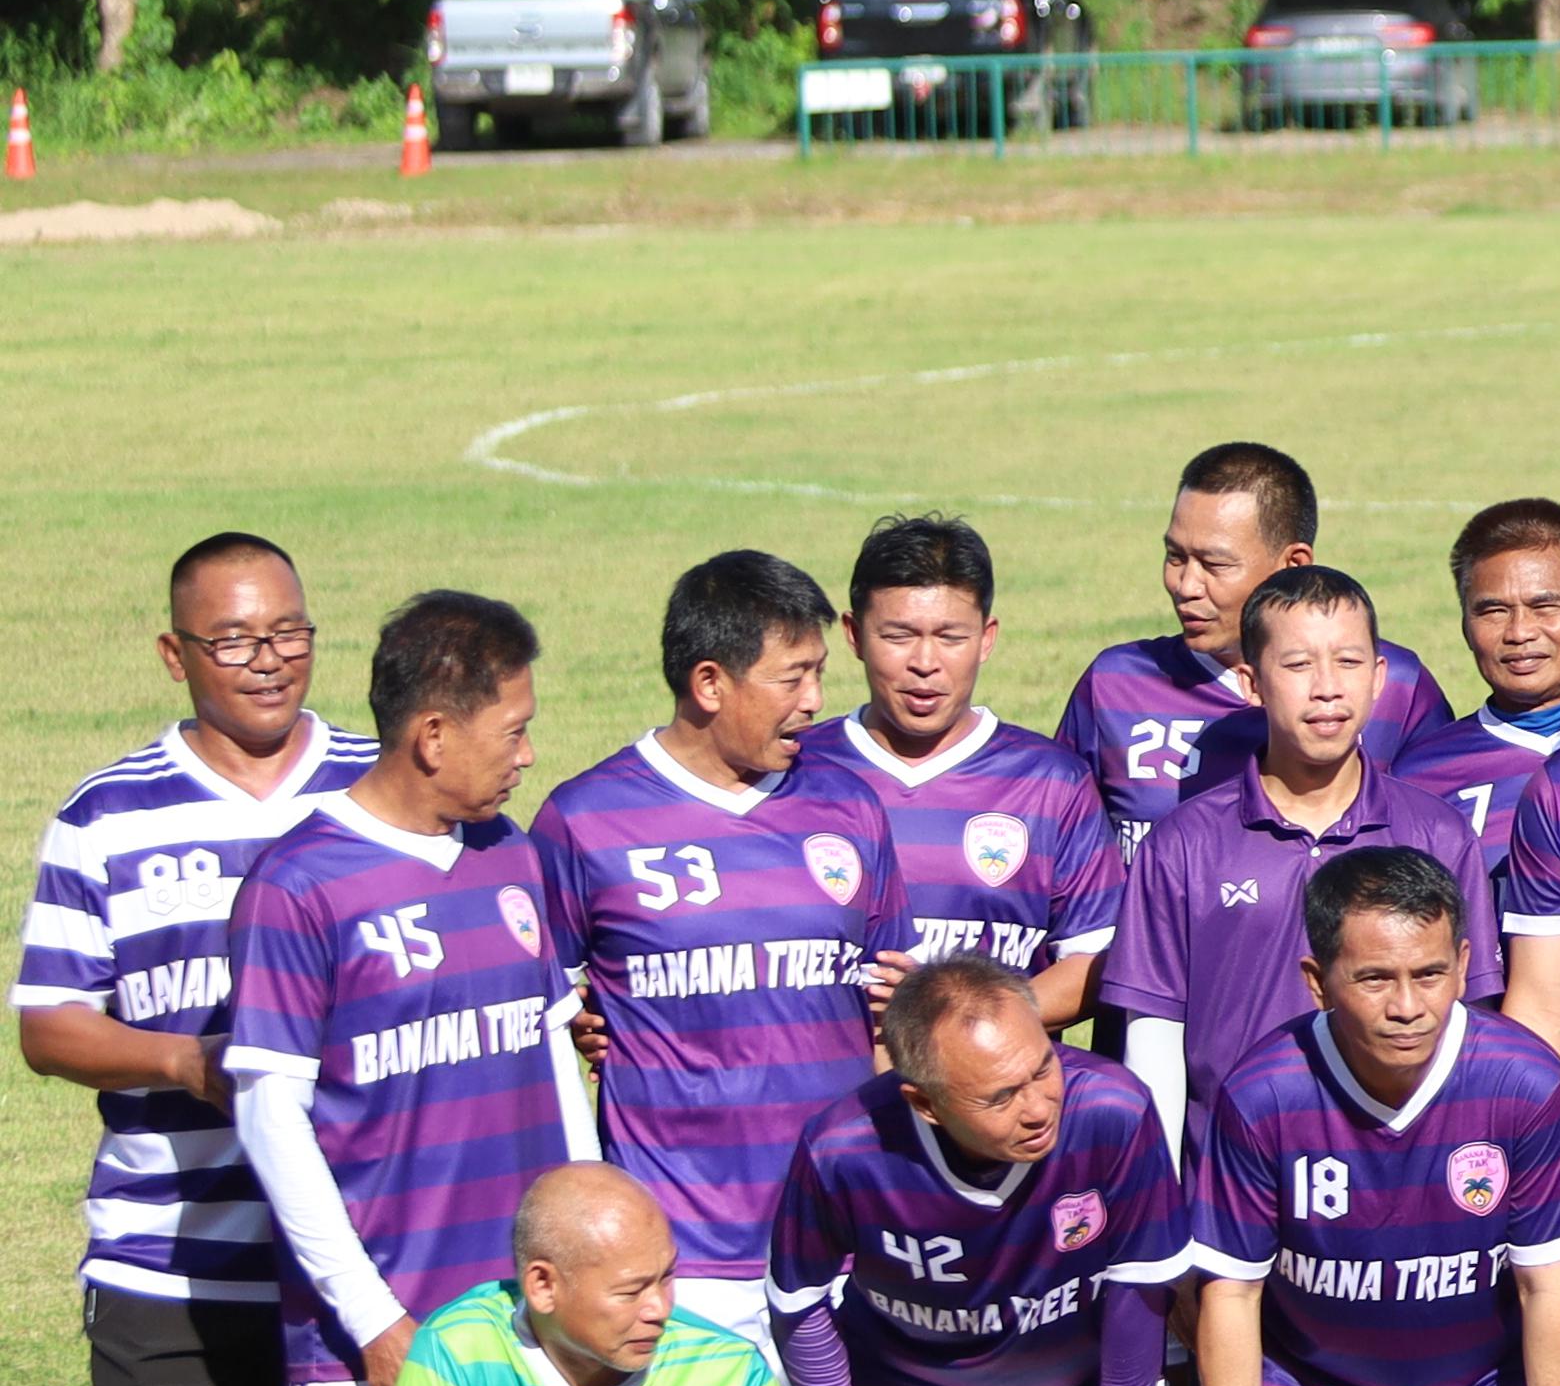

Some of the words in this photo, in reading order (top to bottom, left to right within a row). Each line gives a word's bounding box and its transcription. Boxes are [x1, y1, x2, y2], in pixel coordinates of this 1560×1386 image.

[1127, 718, 1205, 780] 25
[139, 848, 224, 916] 88
[626, 844, 722, 912] 53
[358, 902, 446, 979] 45
[625, 942, 758, 1000] BANANA
[762, 938, 842, 991] TREE
[350, 1010, 481, 1086] BANANA
[481, 996, 545, 1055] TREE
[1292, 1155, 1350, 1221] 18
[1469, 1157, 1489, 1169] TAK
[880, 1229, 969, 1284] 42
[1279, 1247, 1383, 1304] ANANA
[1395, 1250, 1481, 1303] TREE
[867, 1288, 1004, 1336] BANANA
